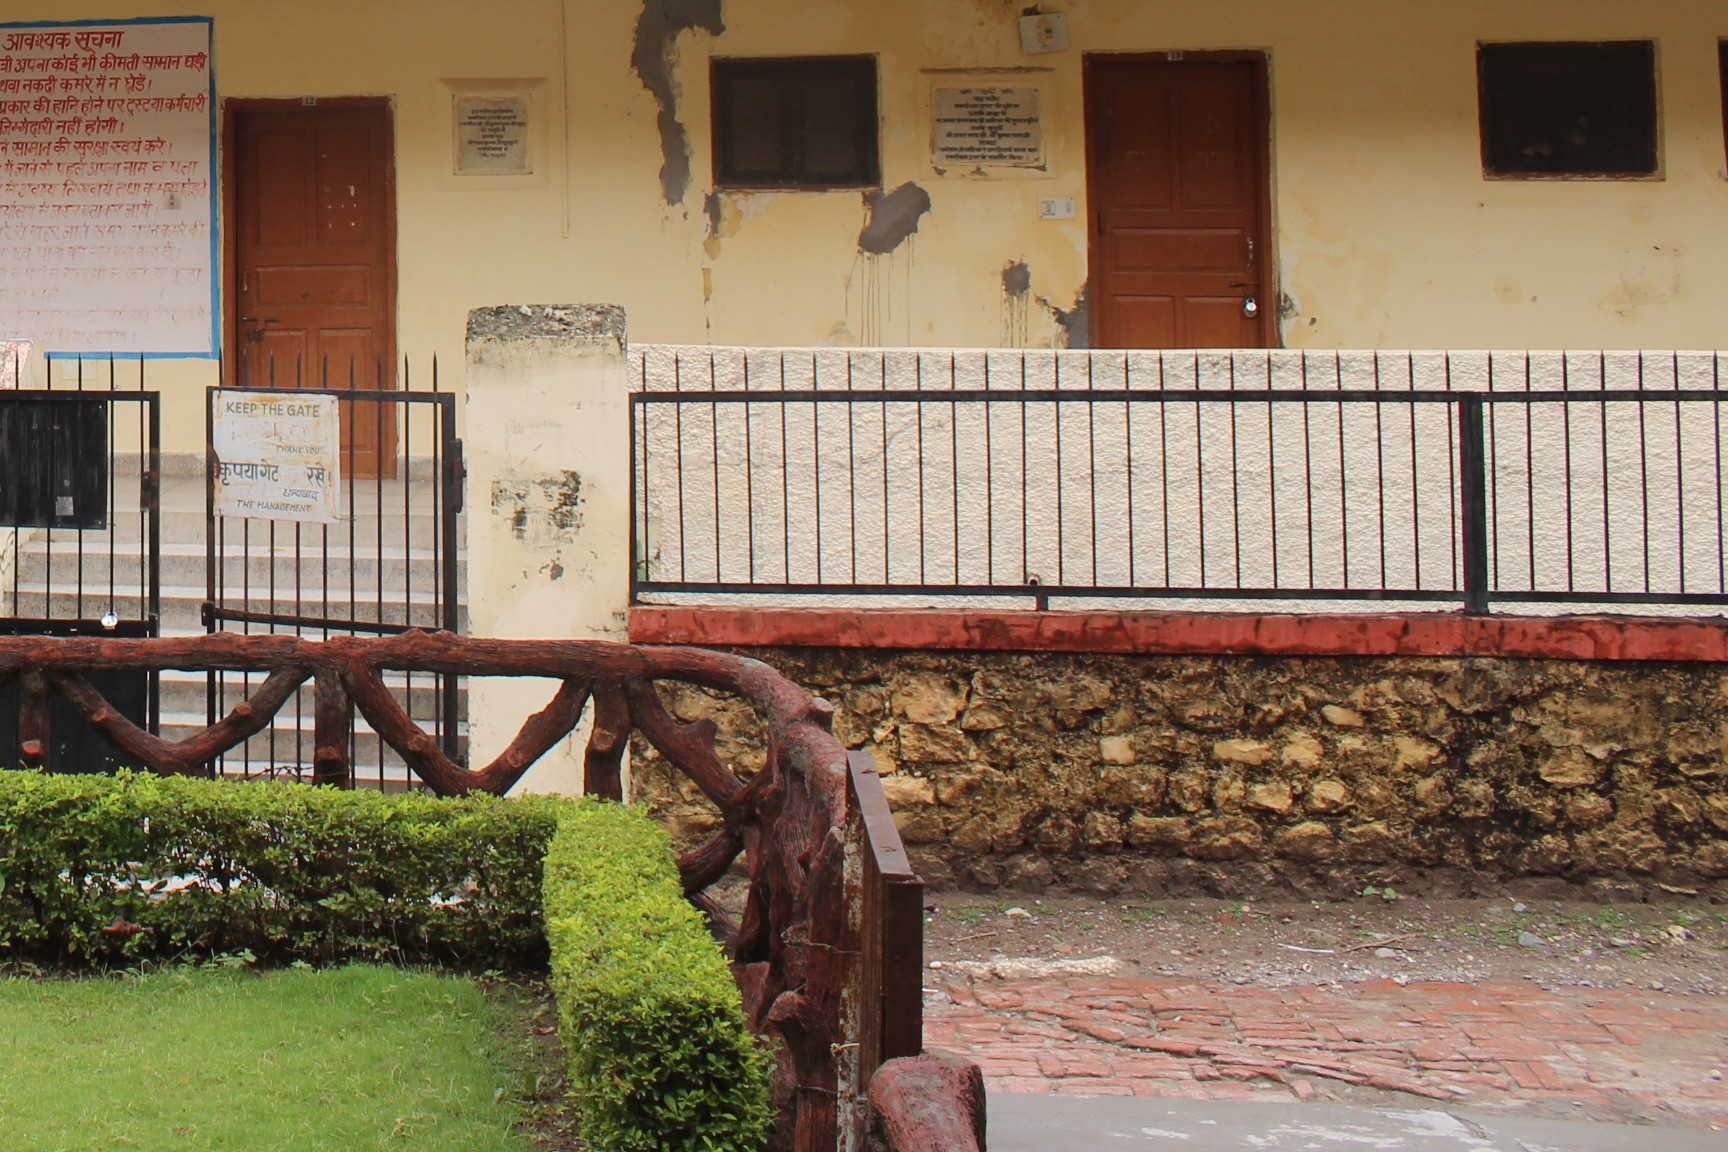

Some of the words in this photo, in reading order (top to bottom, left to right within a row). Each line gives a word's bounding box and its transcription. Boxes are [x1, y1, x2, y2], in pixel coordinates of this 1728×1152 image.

[2, 32, 71, 51] आवश्यक
[75, 31, 125, 53] सूचना
[15, 57, 52, 73] अपना
[52, 53, 80, 74] कोई
[82, 53, 98, 71] भी
[99, 52, 140, 71] कीमती
[142, 54, 182, 70] सामान
[22, 75, 58, 94] नकदी
[59, 75, 94, 93] कमरे
[96, 74, 107, 93] में
[109, 77, 121, 91] न
[33, 95, 51, 115] की
[53, 95, 79, 116] हानि
[81, 95, 105, 116] होने
[107, 98, 125, 114] पर
[56, 116, 83, 136] नहीं
[12, 141, 53, 157] सामान
[53, 136, 72, 156] की
[73, 140, 109, 162] सुरक्षा
[123, 160, 149, 176] नाम
[226, 401, 257, 415] KEEP
[260, 402, 284, 416] THE
[286, 404, 321, 418] GATE
[219, 461, 259, 486] कृपया
[259, 458, 280, 483] गेट
[237, 499, 254, 509] THE
[256, 500, 312, 513] MANAGEMENT
